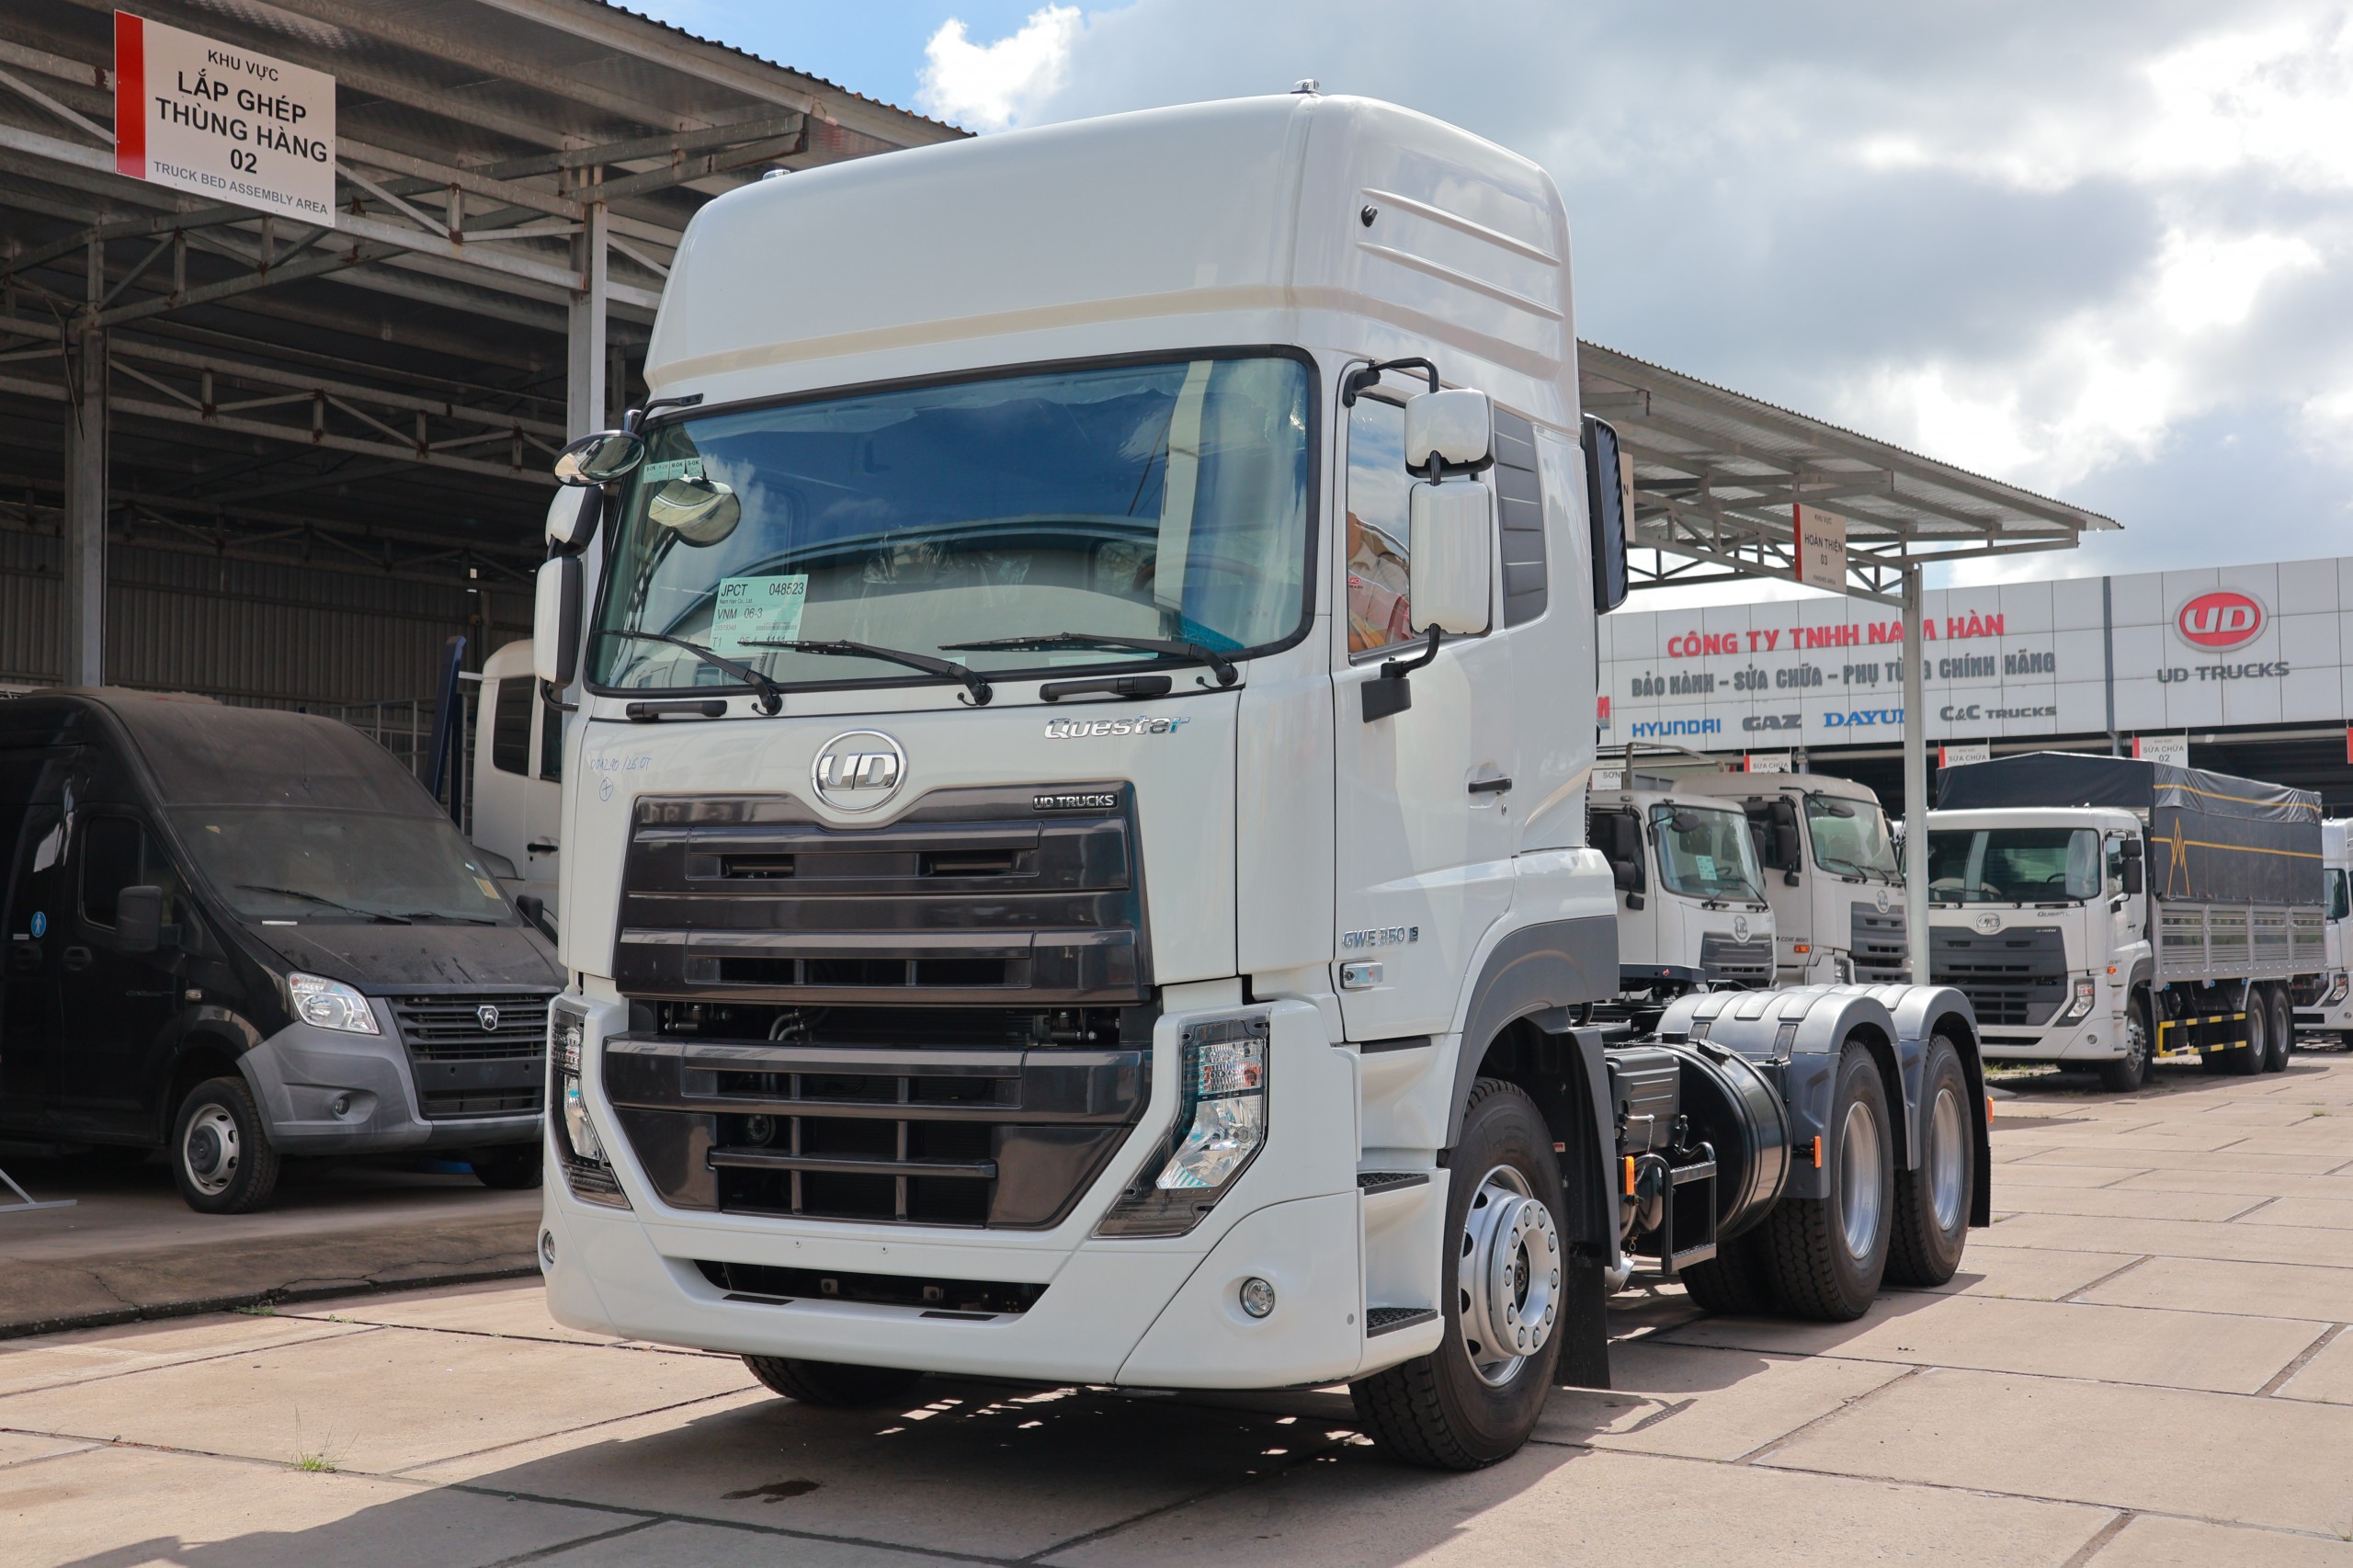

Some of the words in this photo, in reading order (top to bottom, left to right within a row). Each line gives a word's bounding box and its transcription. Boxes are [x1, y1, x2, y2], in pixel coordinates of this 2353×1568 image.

[208, 50, 241, 71] KHU
[245, 61, 278, 82] VỰC
[178, 69, 229, 102] LẮP
[237, 89, 306, 124] GHÉP
[155, 97, 247, 141] THÙNG
[257, 125, 327, 163] HÀNG
[231, 149, 257, 174] 02
[153, 161, 198, 182] TRUCK
[201, 173, 226, 189] BED
[230, 181, 293, 206] ASSEMBLY
[296, 198, 327, 215] AREA
[1821, 553, 1828, 565] 03
[721, 584, 748, 597] JPCT
[769, 582, 804, 596] 048523
[717, 608, 738, 619] VNM
[744, 608, 763, 619] 06-3
[2184, 605, 2256, 634] UD
[1667, 631, 1738, 657] CÔNG
[1745, 629, 1779, 652] TY
[1790, 624, 1859, 649] TNHH
[1948, 609, 2005, 640] HÀN
[1631, 671, 1665, 697] BẢO
[1670, 671, 1714, 695] HÀNH
[1734, 664, 1768, 691] SỬA
[1776, 663, 1823, 688] CHỮA
[1843, 664, 1879, 687] PHỤ
[1939, 653, 1995, 679] CHÍNH
[2005, 649, 2055, 675] HÃNG
[2157, 667, 2188, 684] UD
[2195, 661, 2290, 681] TRUCKS
[1743, 713, 1802, 732] GAZ
[1940, 705, 1981, 722] C&C
[1985, 706, 2057, 720] TRUCKS
[1044, 715, 1190, 740] Quester
[1632, 718, 1721, 737] HYUNDAI
[818, 752, 899, 790] UD
[1034, 796, 1054, 808] UD
[1056, 794, 1114, 808] TRUCKS
[1342, 929, 1376, 949] GWE
